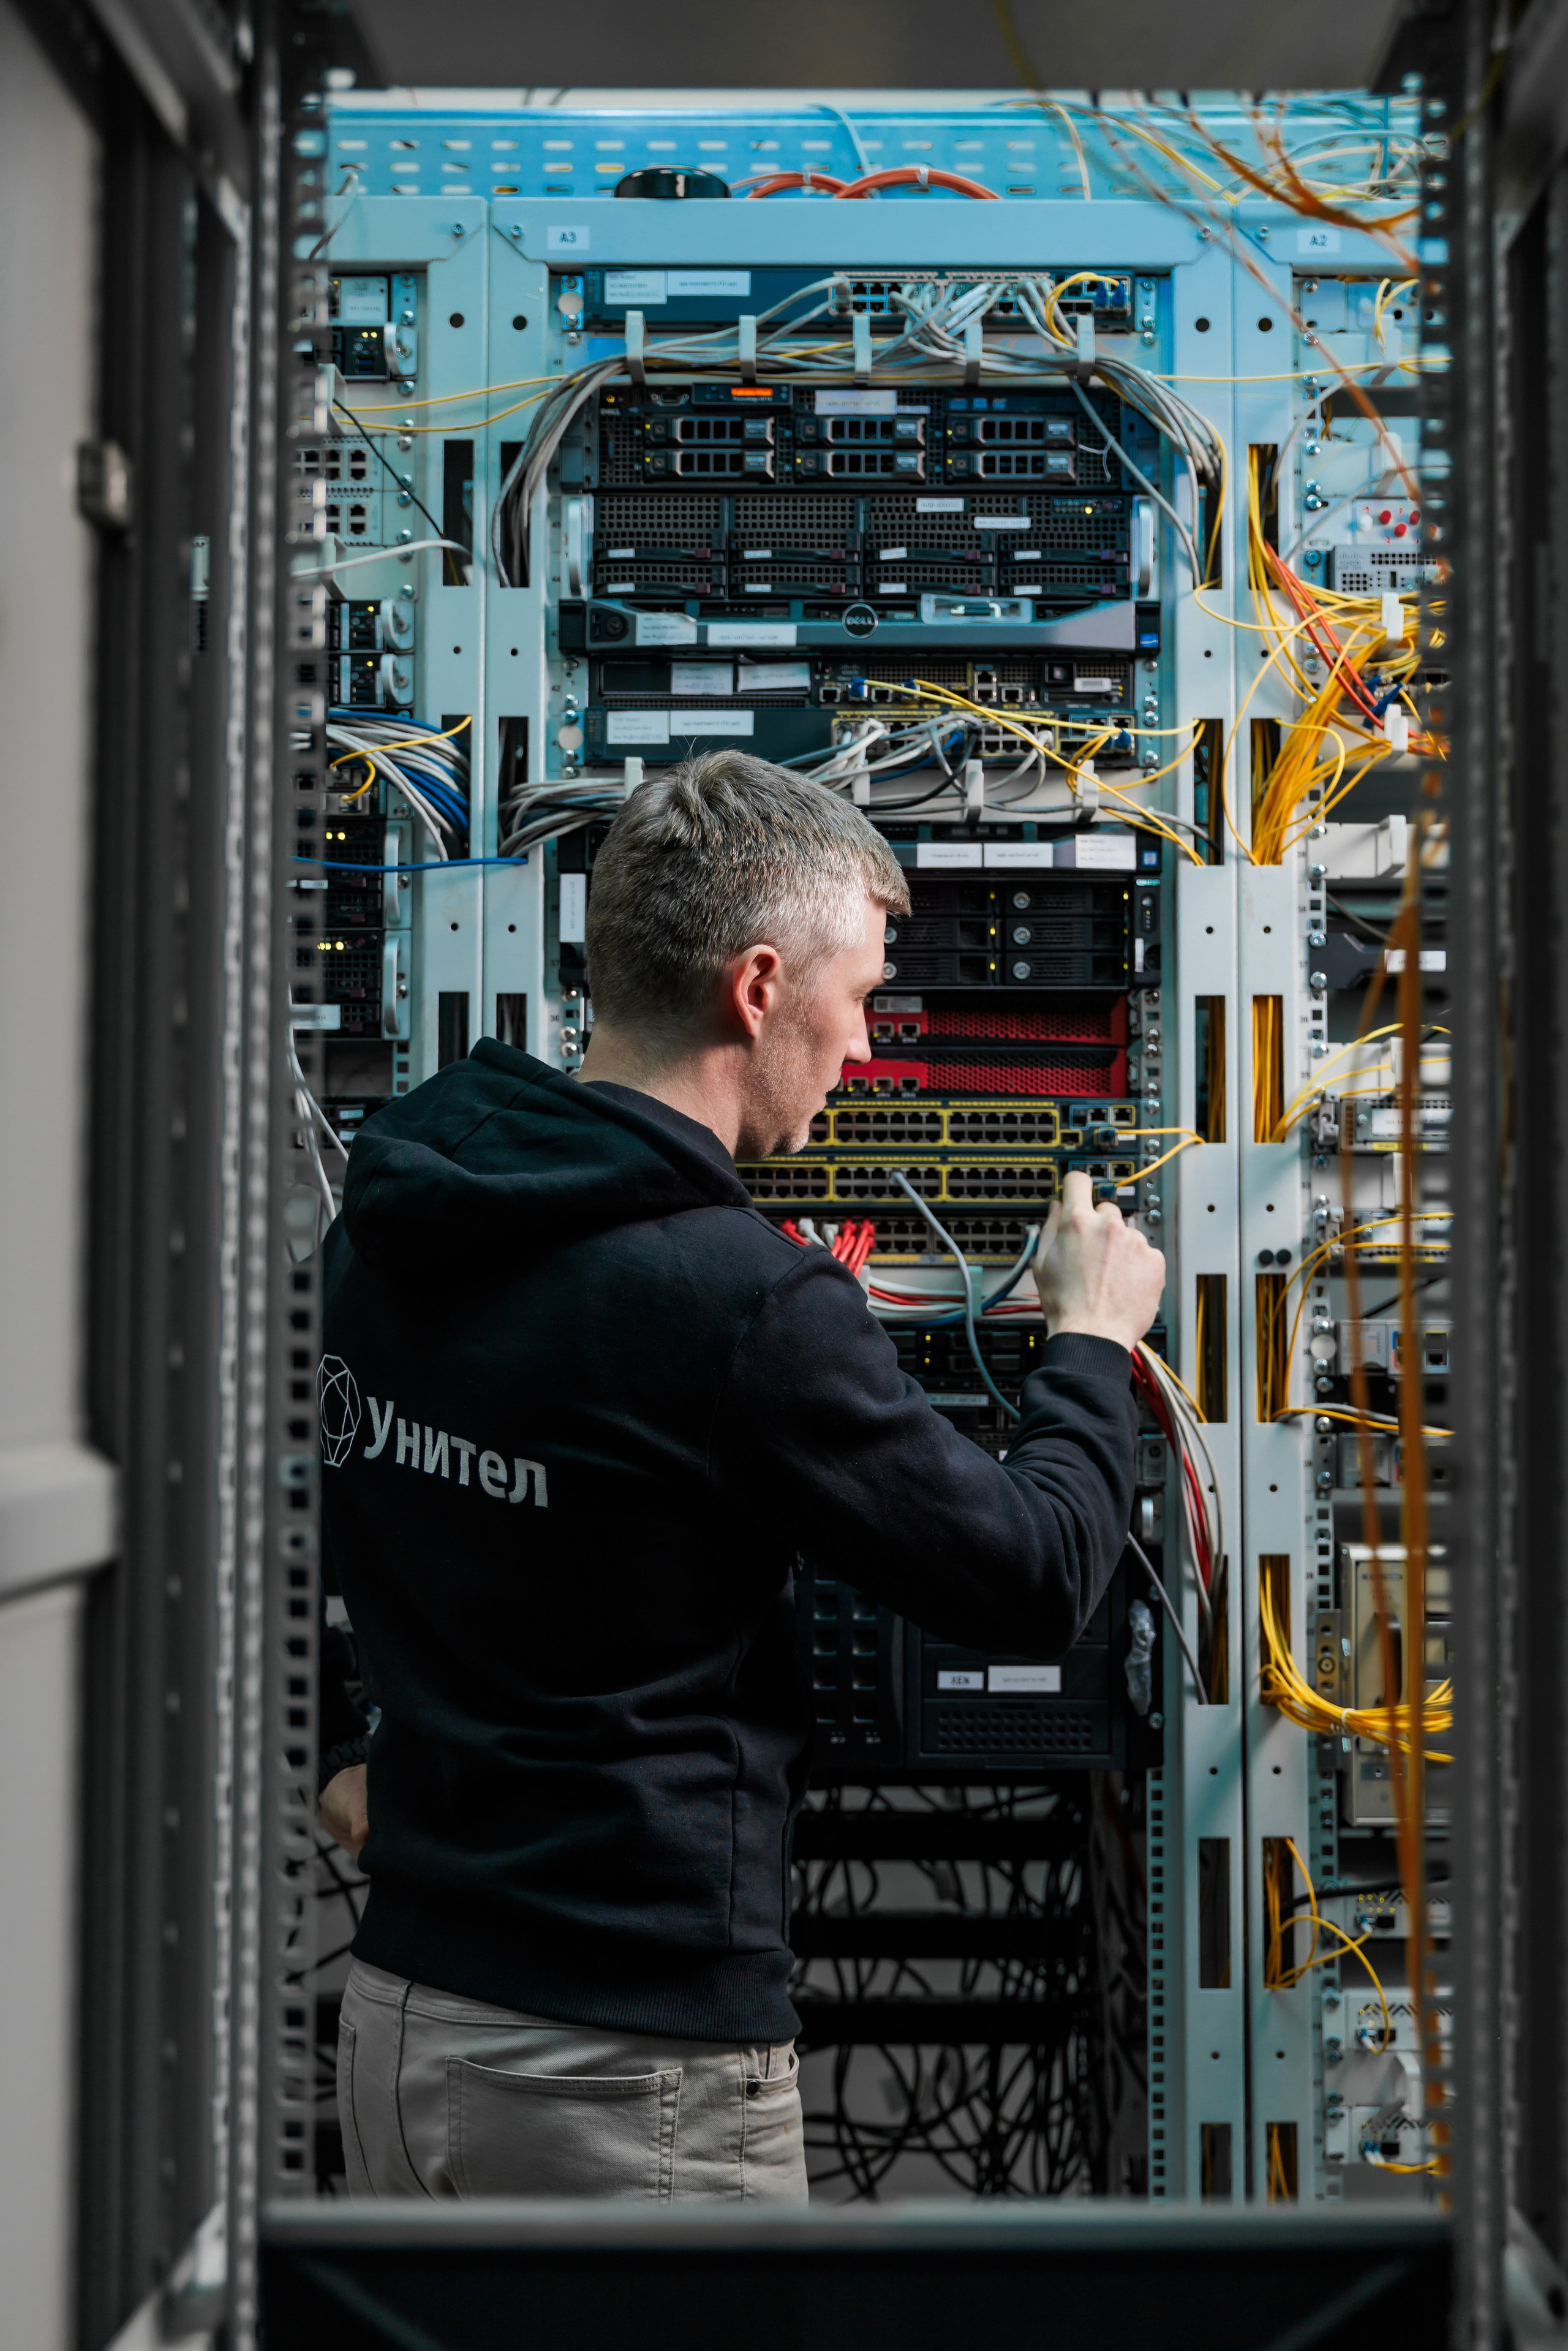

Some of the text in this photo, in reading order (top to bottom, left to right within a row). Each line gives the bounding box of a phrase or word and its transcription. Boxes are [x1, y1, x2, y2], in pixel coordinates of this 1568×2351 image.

[559, 232, 576, 244] A3
[1310, 235, 1328, 247] A2
[846, 616, 874, 625] DELL
[364, 1397, 548, 1508] Унител
